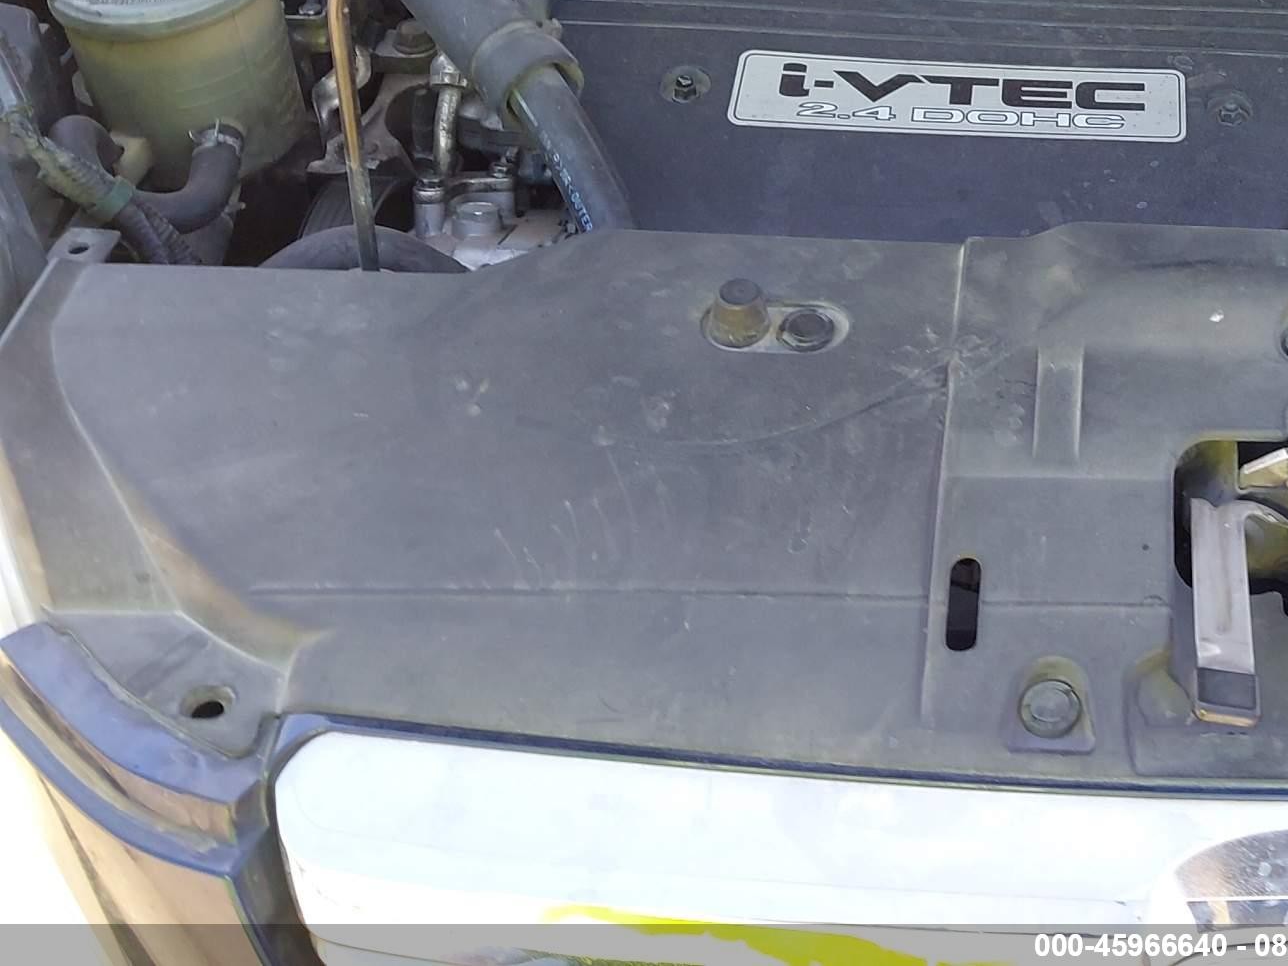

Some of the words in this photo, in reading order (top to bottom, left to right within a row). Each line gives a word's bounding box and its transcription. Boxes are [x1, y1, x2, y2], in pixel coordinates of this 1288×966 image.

[779, 62, 1146, 111] i-VTEC
[796, 101, 896, 121] 2.4
[911, 106, 1127, 129] DOHC
